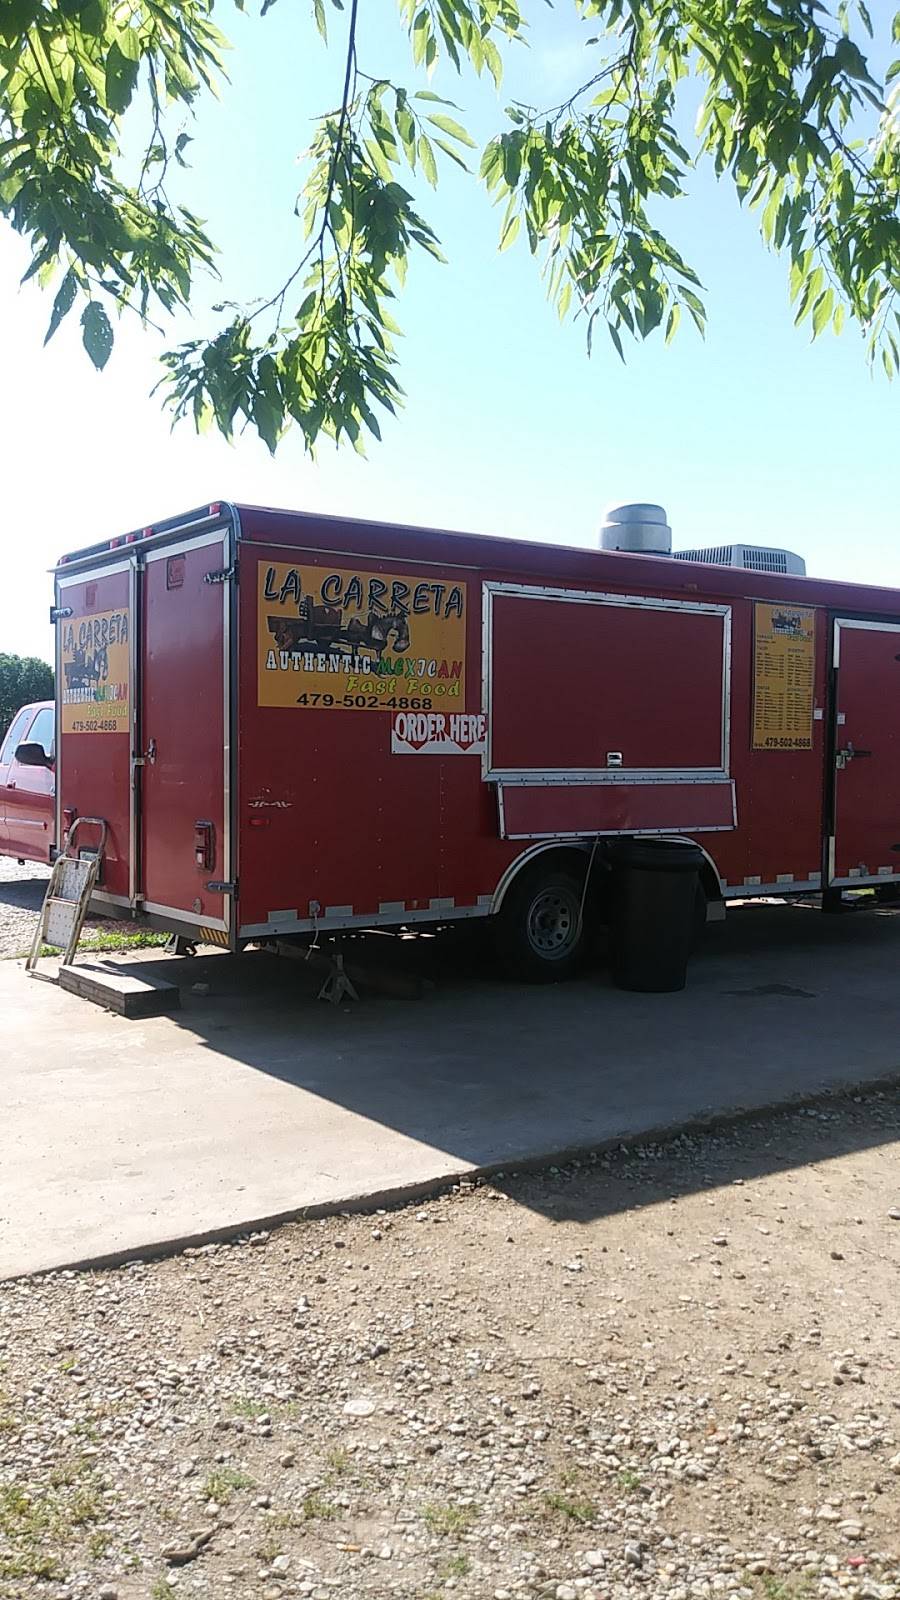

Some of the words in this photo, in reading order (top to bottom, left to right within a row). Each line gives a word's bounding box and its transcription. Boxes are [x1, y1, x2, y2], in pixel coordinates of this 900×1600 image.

[264, 566, 301, 604] LA
[320, 573, 464, 619] CARRETA
[63, 623, 74, 654] LA
[78, 612, 128, 651] CARRETA
[266, 650, 372, 675] AUTHENTIC
[376, 656, 463, 680] MEXICAN
[347, 675, 398, 697] Fast
[406, 678, 461, 697] Food
[296, 693, 433, 711] 479-502-4868
[72, 720, 117, 732] 479-502-4868
[395, 712, 447, 743] ORDER
[449, 714, 487, 743] HERE
